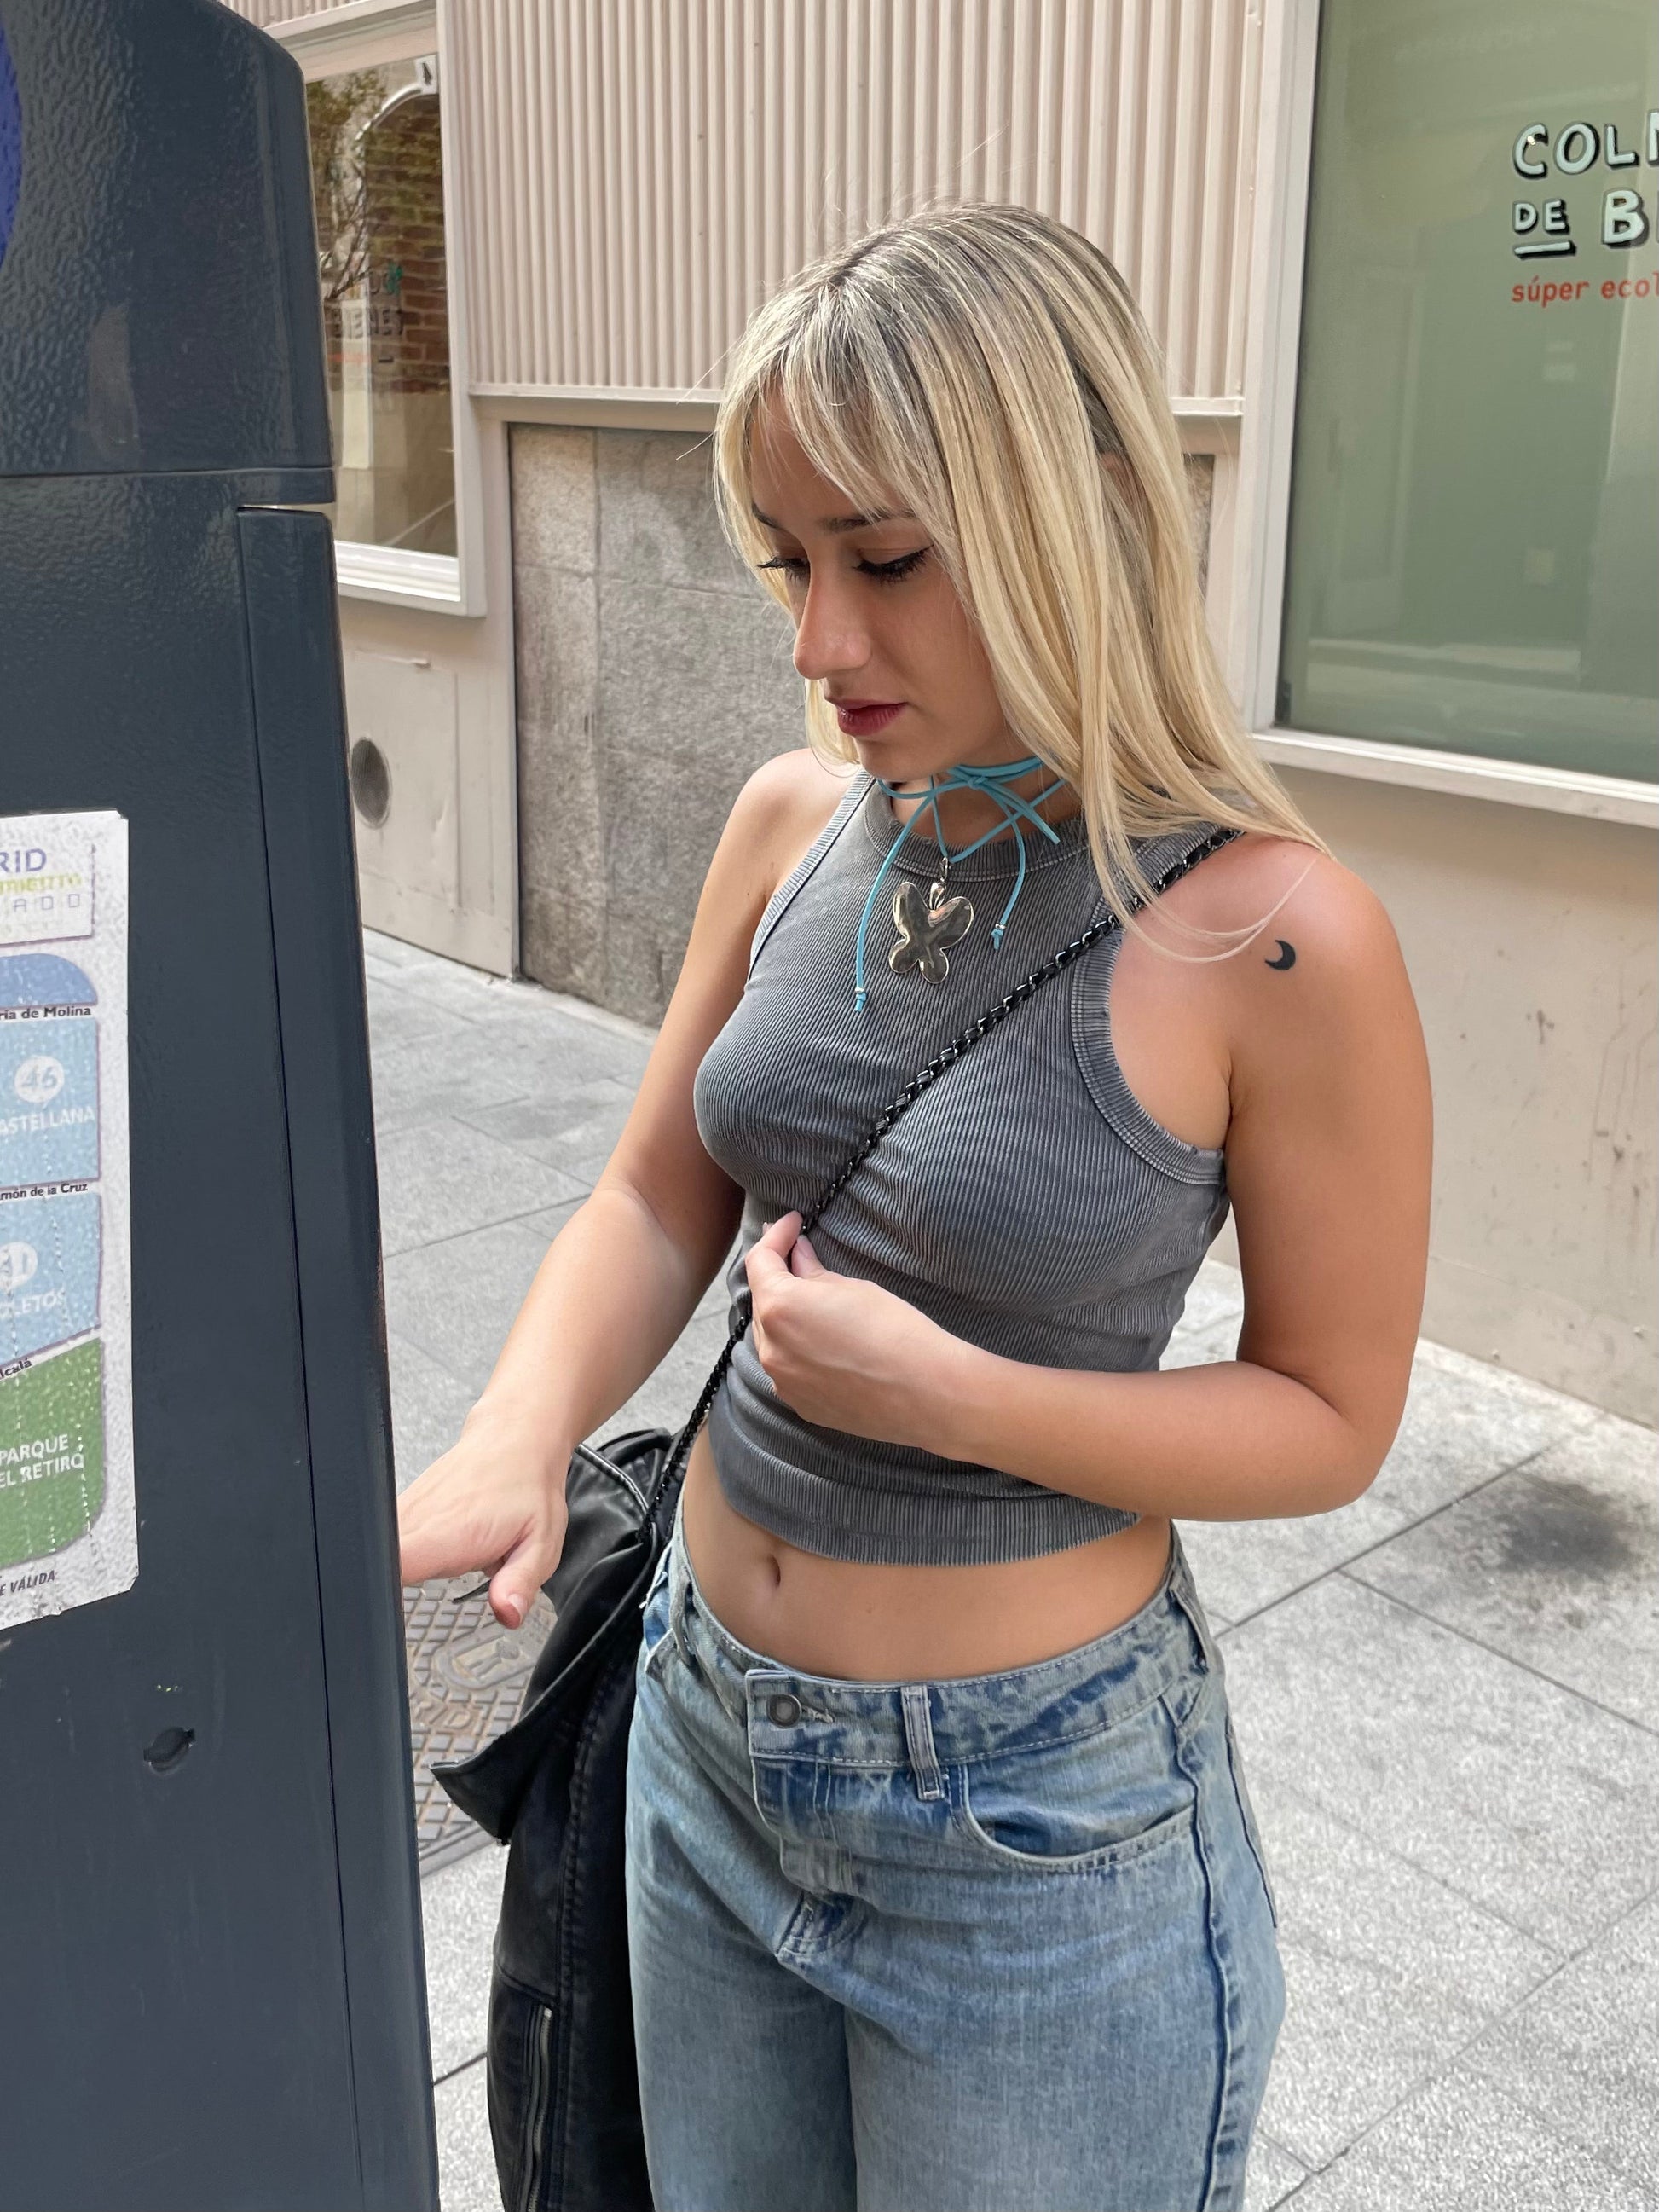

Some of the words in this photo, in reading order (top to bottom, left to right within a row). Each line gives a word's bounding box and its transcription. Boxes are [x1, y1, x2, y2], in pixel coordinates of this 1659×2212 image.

[1513, 199, 1569, 235] DE
[1603, 188, 1659, 248] B
[1512, 275, 1590, 308] súper
[21, 1008, 39, 1019] de
[43, 1006, 91, 1017] Molina
[30, 1186, 44, 1197] de
[47, 1184, 57, 1195] la
[61, 1183, 88, 1193] Cruz
[20, 1452, 84, 1484] RETIRO
[10, 1569, 55, 1594] VÁLIDA
